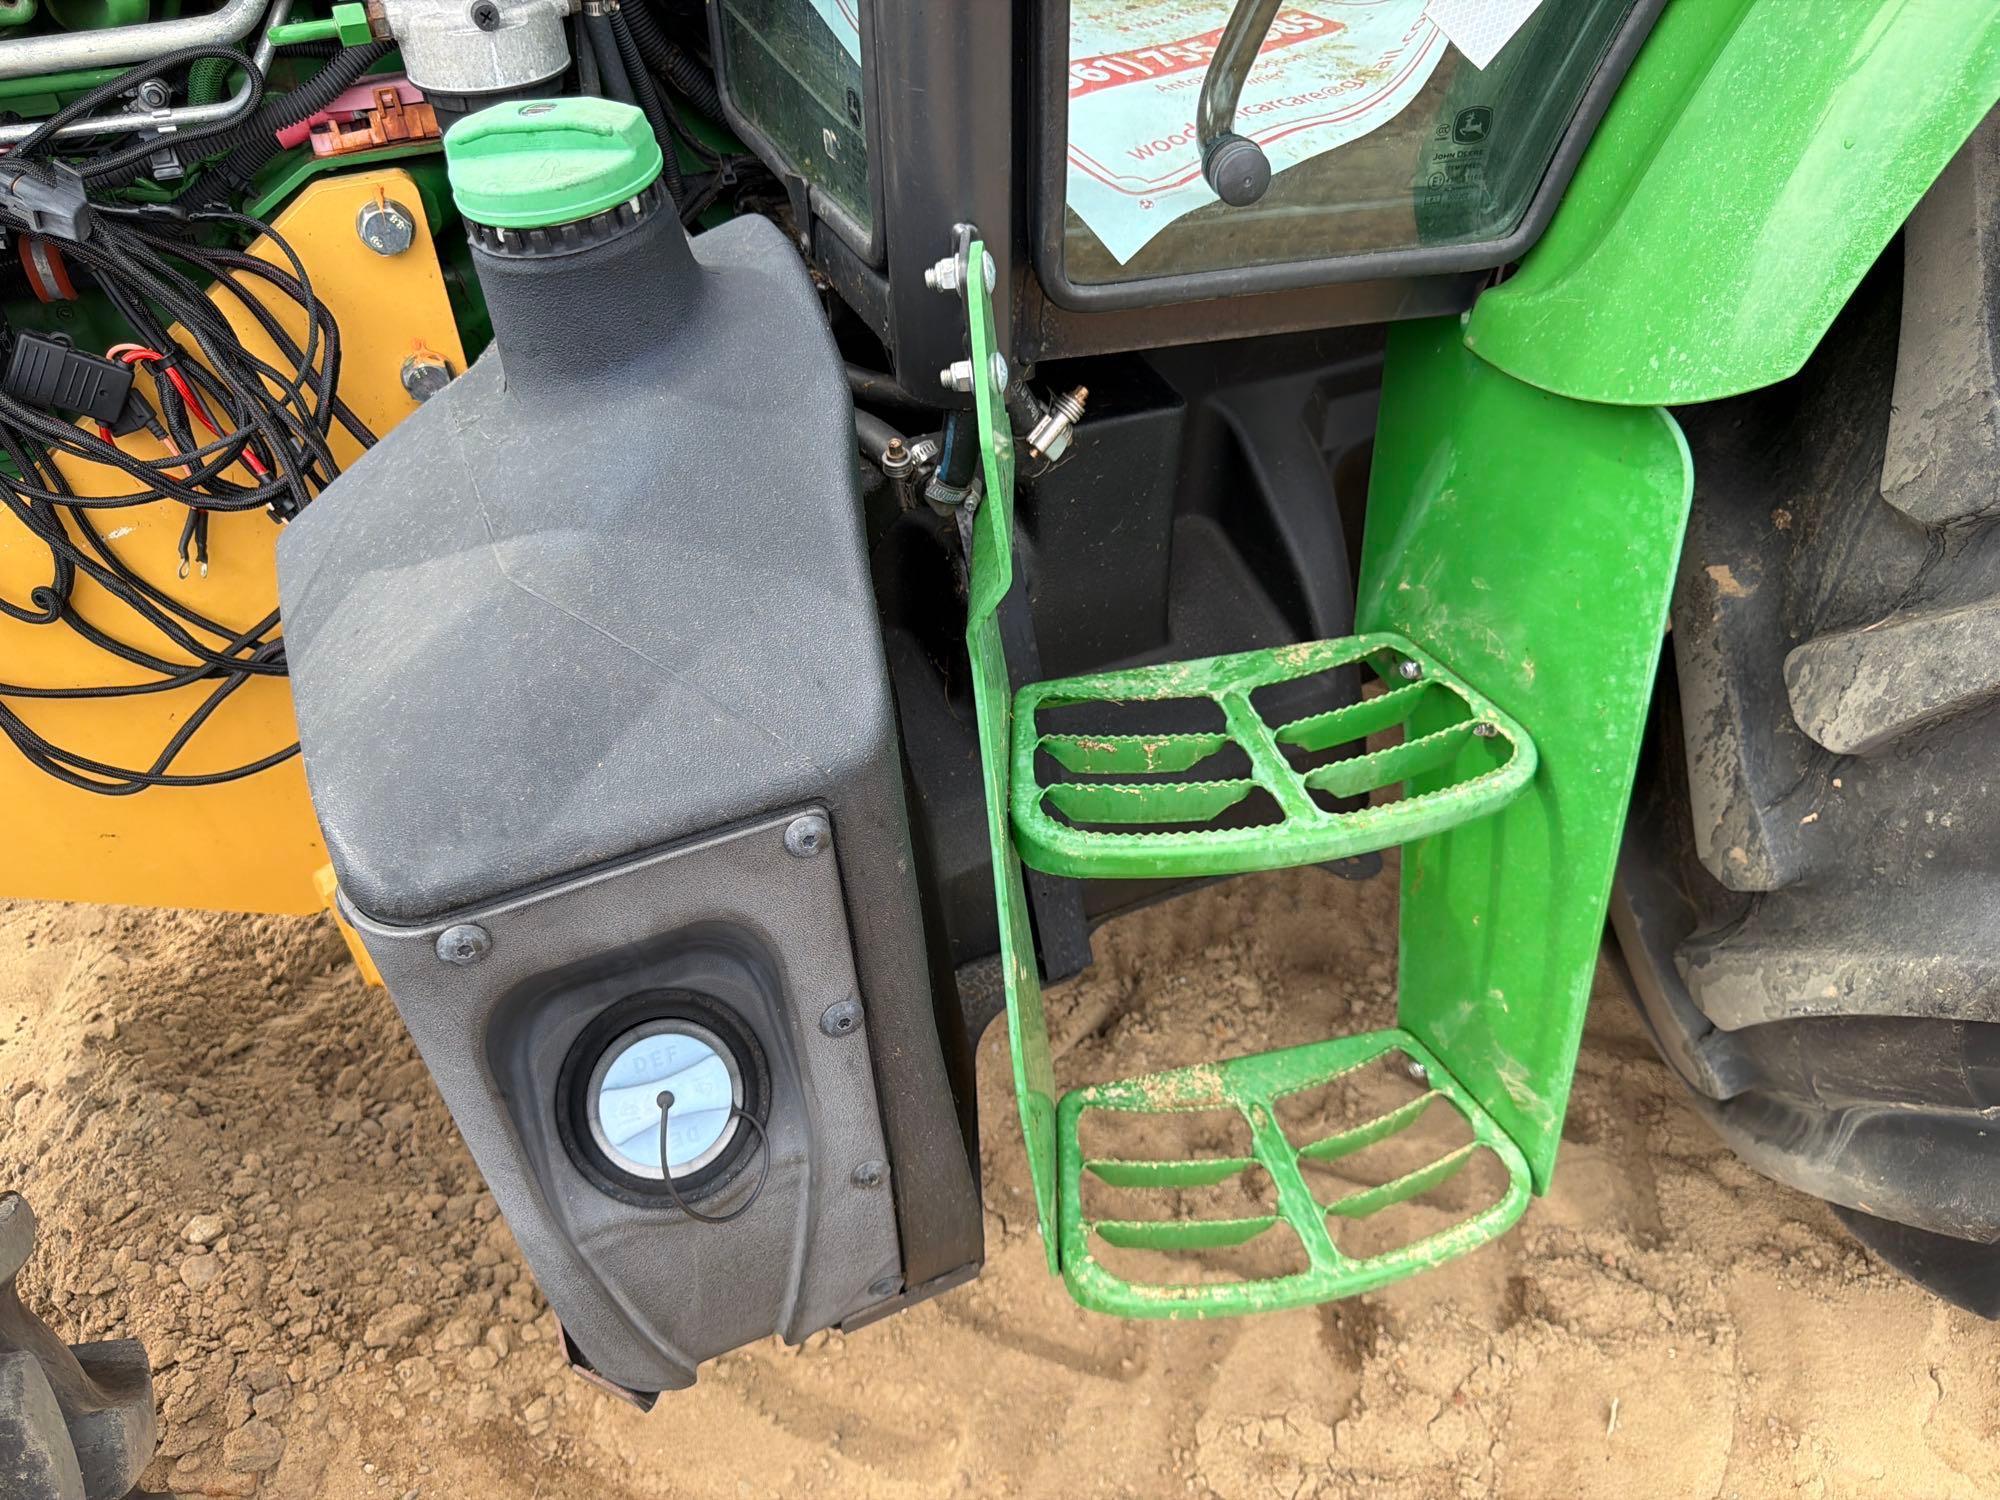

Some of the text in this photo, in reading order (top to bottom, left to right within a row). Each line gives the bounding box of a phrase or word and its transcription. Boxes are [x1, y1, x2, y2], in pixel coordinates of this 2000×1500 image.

[1432, 152, 1455, 161] JOHN
[633, 1044, 678, 1074] DEF
[668, 1126, 699, 1149] DE
